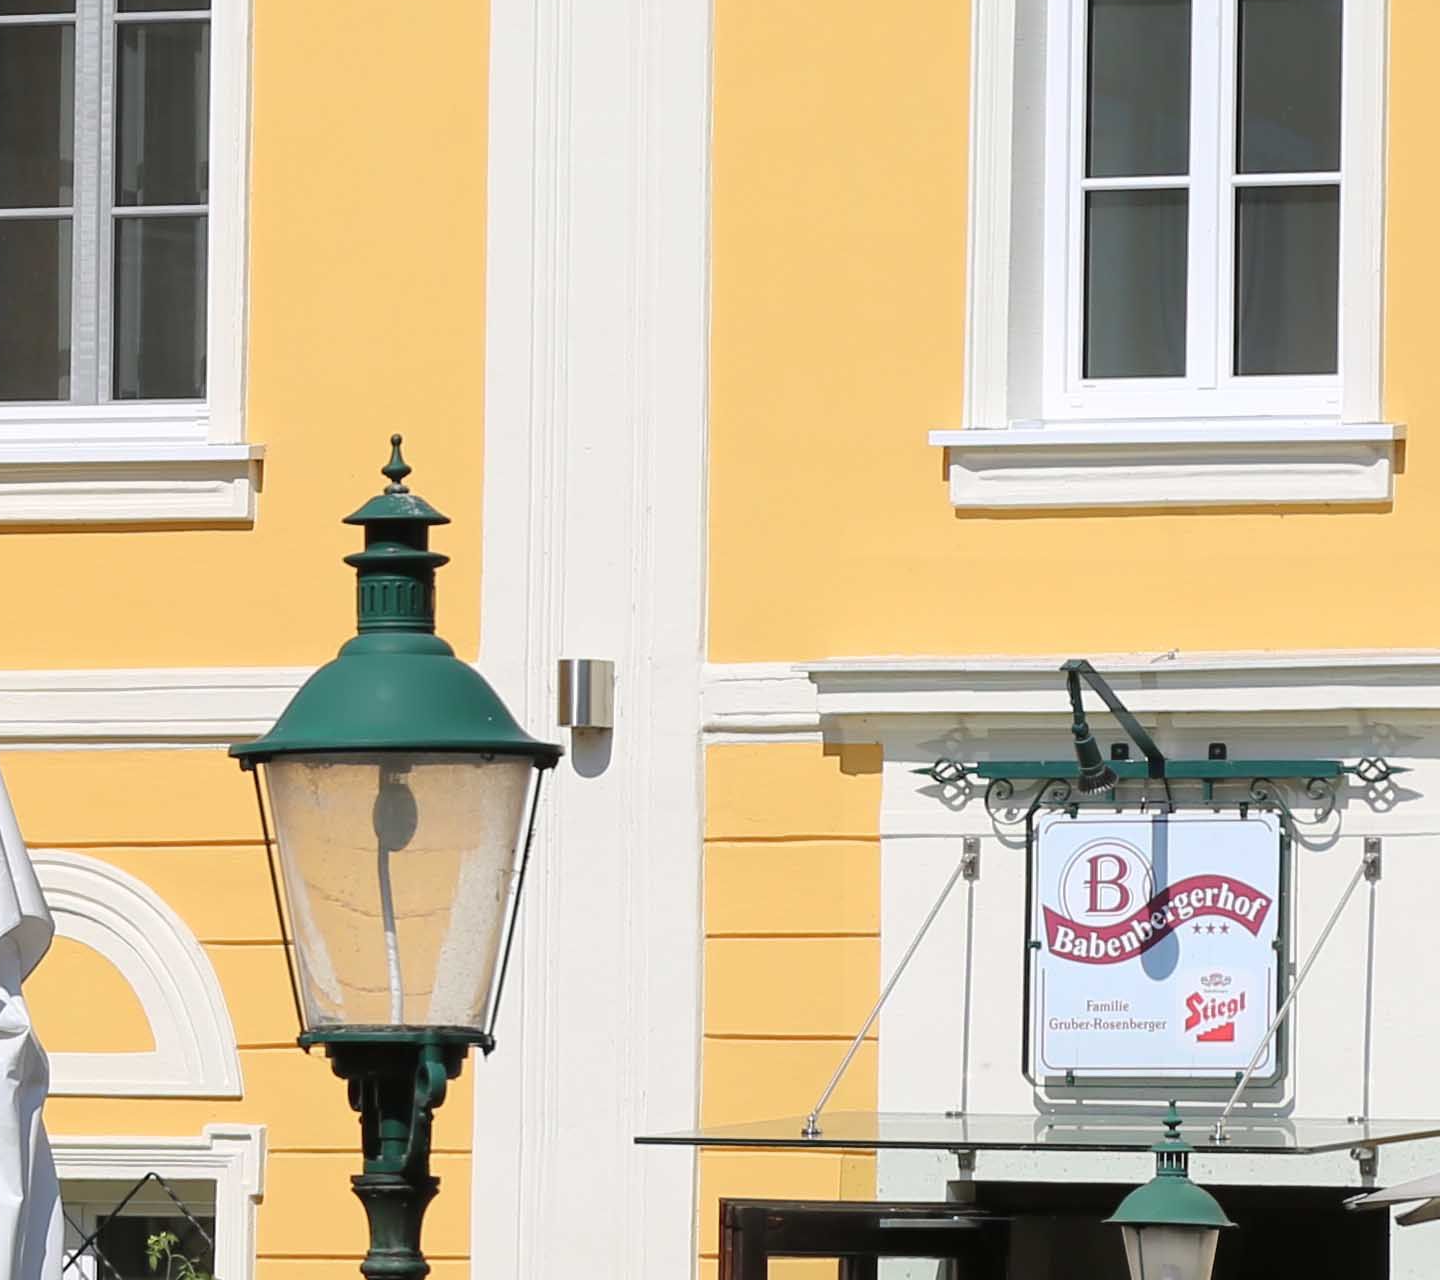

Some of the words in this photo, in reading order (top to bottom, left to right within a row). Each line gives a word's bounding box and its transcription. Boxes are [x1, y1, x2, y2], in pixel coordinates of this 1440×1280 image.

[1083, 854, 1133, 916] B
[1051, 883, 1268, 958] Babenbergerhof
[1049, 1018, 1167, 1032] Gruber-Rosenberger
[1086, 1000, 1129, 1012] Familie
[1185, 991, 1246, 1032] Stiegl
